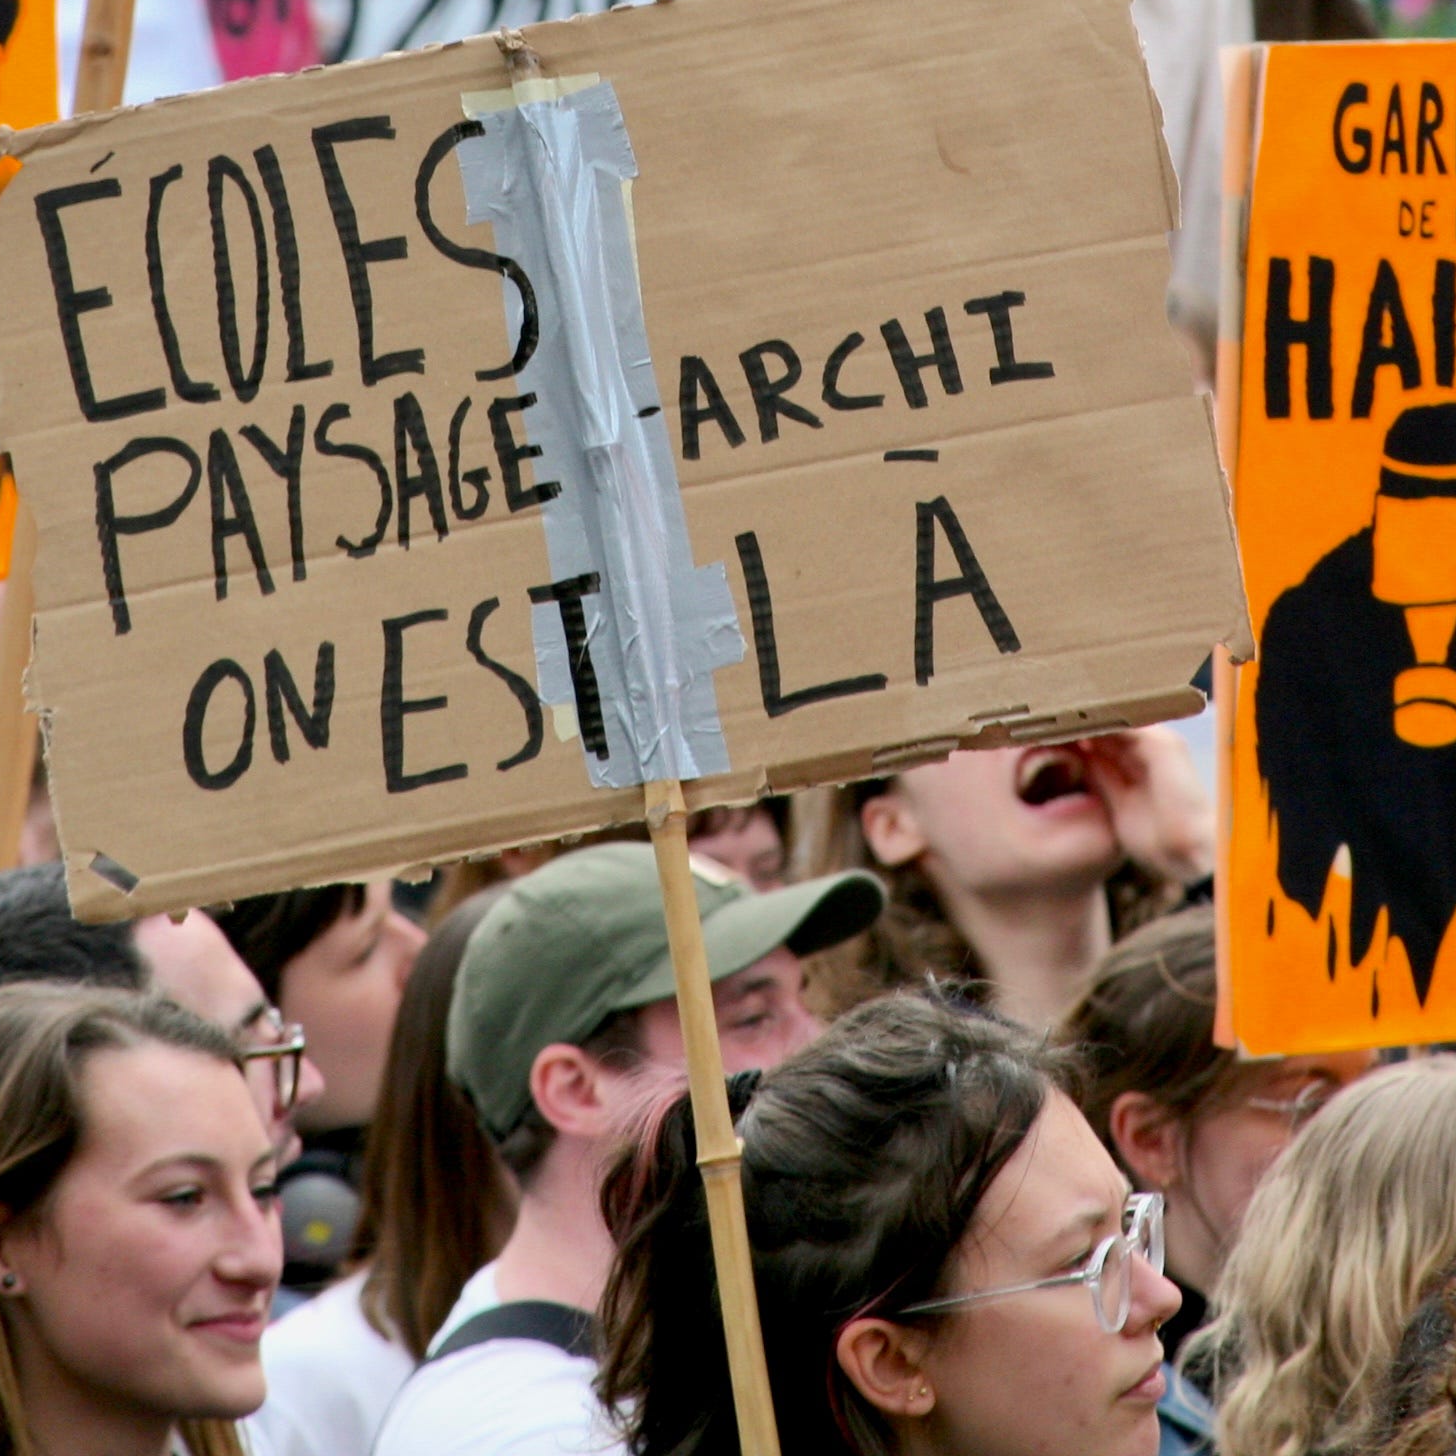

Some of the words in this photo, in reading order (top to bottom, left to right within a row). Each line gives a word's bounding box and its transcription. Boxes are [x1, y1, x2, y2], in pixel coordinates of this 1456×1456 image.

[34, 114, 540, 422] ÉCOLES
[1397, 200, 1438, 240] DE
[93, 390, 564, 636] PAYSAGE
[182, 640, 336, 791] ON
[380, 571, 611, 794] EST
